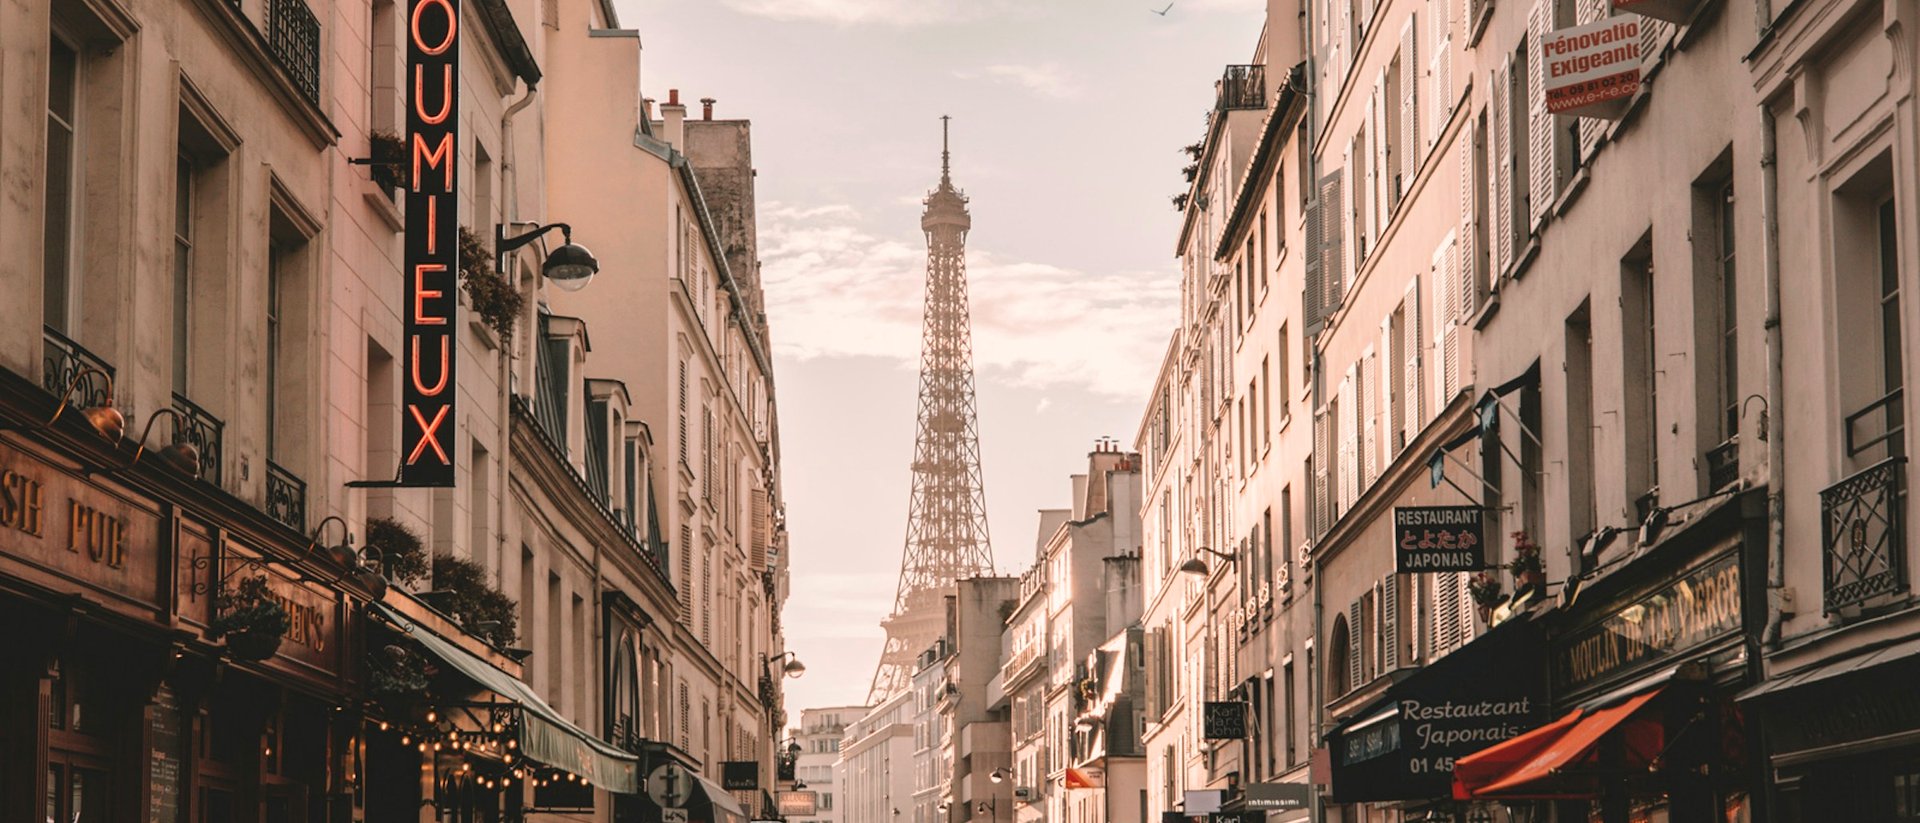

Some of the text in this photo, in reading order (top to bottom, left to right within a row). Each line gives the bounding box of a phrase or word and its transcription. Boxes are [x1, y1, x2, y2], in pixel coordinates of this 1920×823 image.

[1544, 22, 1638, 58] rénovatio
[1569, 85, 1584, 96] 09
[406, 0, 457, 466] OUMIEUX
[1397, 510, 1478, 525] RESTAURANT
[67, 497, 127, 570] PUB
[1400, 530, 1477, 550] とよたか
[1405, 552, 1473, 568] JAPONAIS
[1570, 626, 1620, 684] MOULIN
[1625, 619, 1645, 664] DE
[1649, 600, 1674, 650] LA
[1677, 564, 1741, 641] VIERGE
[1212, 705, 1240, 717] Karl
[1401, 697, 1530, 720] Restaurant
[1206, 715, 1240, 726] Marc
[1207, 726, 1240, 737] John
[1416, 722, 1519, 750] Japonais
[1410, 756, 1454, 774] 01 45
